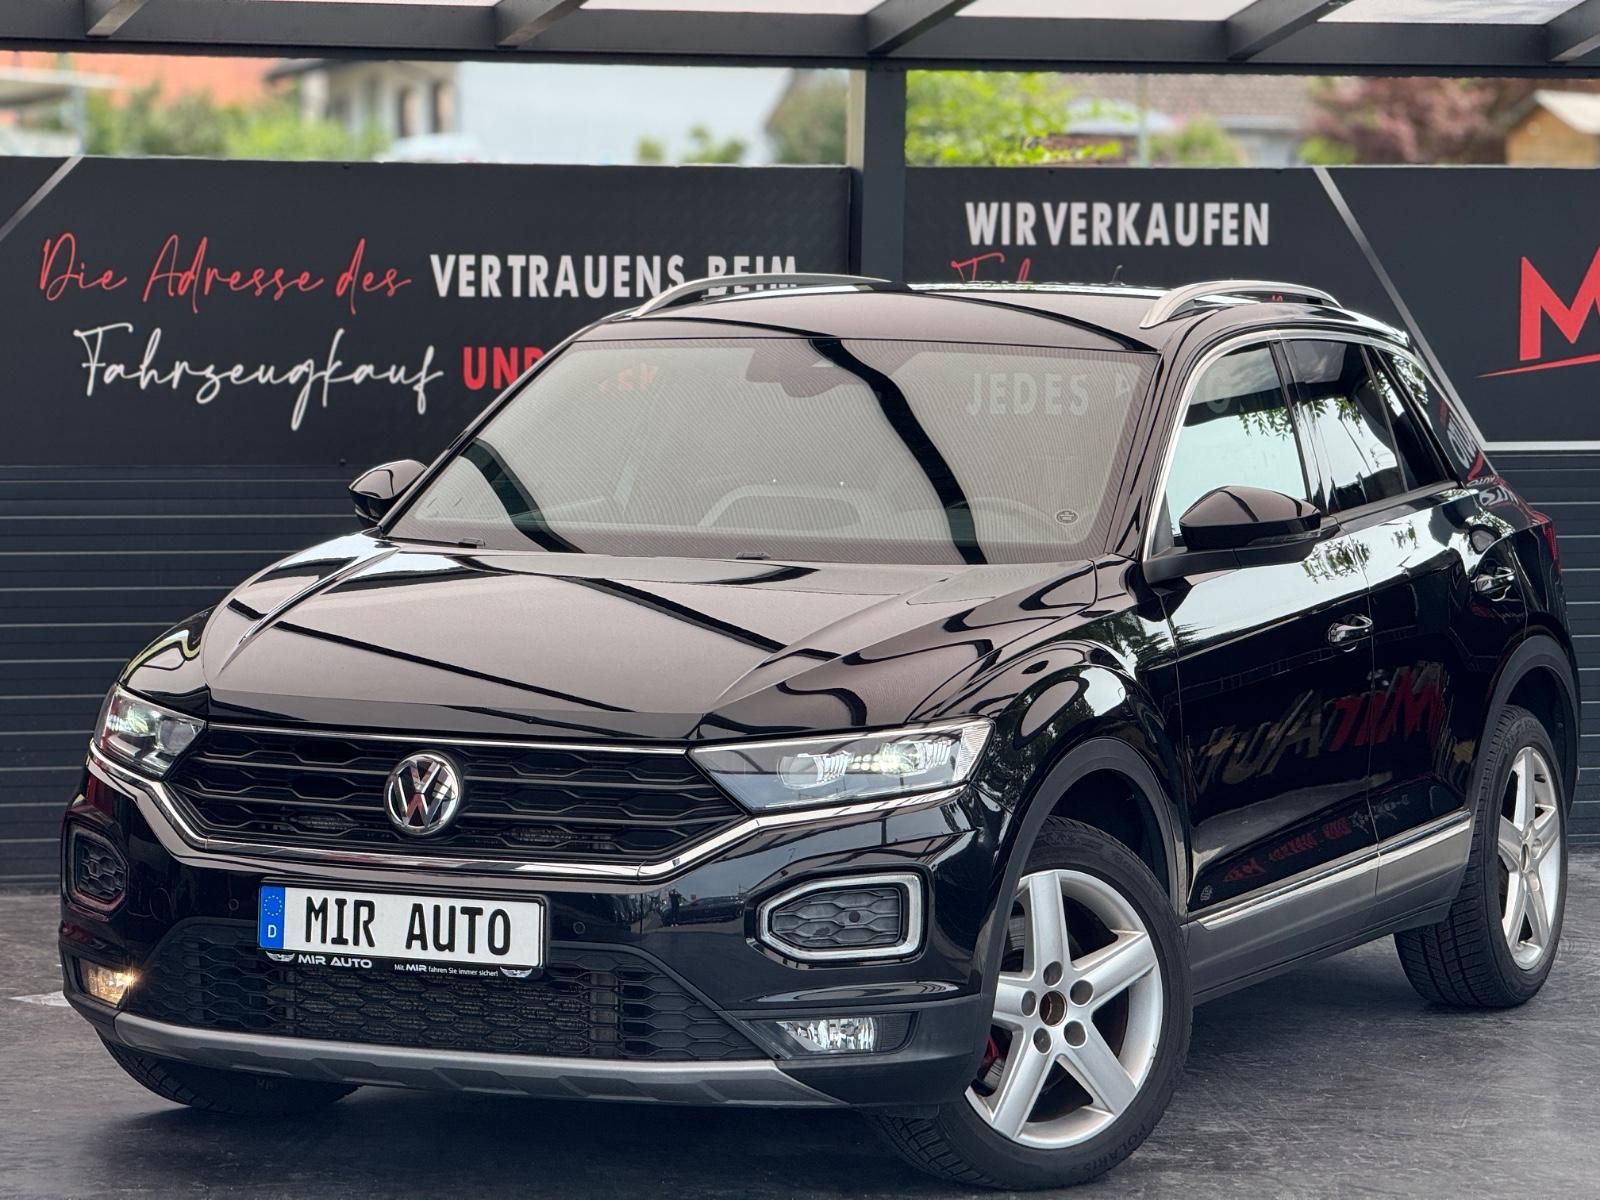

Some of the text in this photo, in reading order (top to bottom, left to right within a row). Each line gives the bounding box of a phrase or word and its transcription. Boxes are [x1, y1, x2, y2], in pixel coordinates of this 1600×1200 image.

[40, 232, 128, 301] Die
[142, 234, 324, 314] Adresse
[335, 238, 412, 315] des
[429, 254, 685, 298] VERTRAUENS
[73, 322, 445, 431] Fahrzeugkauf
[967, 372, 1089, 416] JEDES
[267, 924, 277, 938] D
[305, 896, 511, 956] MIR AUTO
[298, 954, 373, 969] MIR AUTO
[394, 963, 498, 977] Mit MIR fahren Sie immer sicher!
